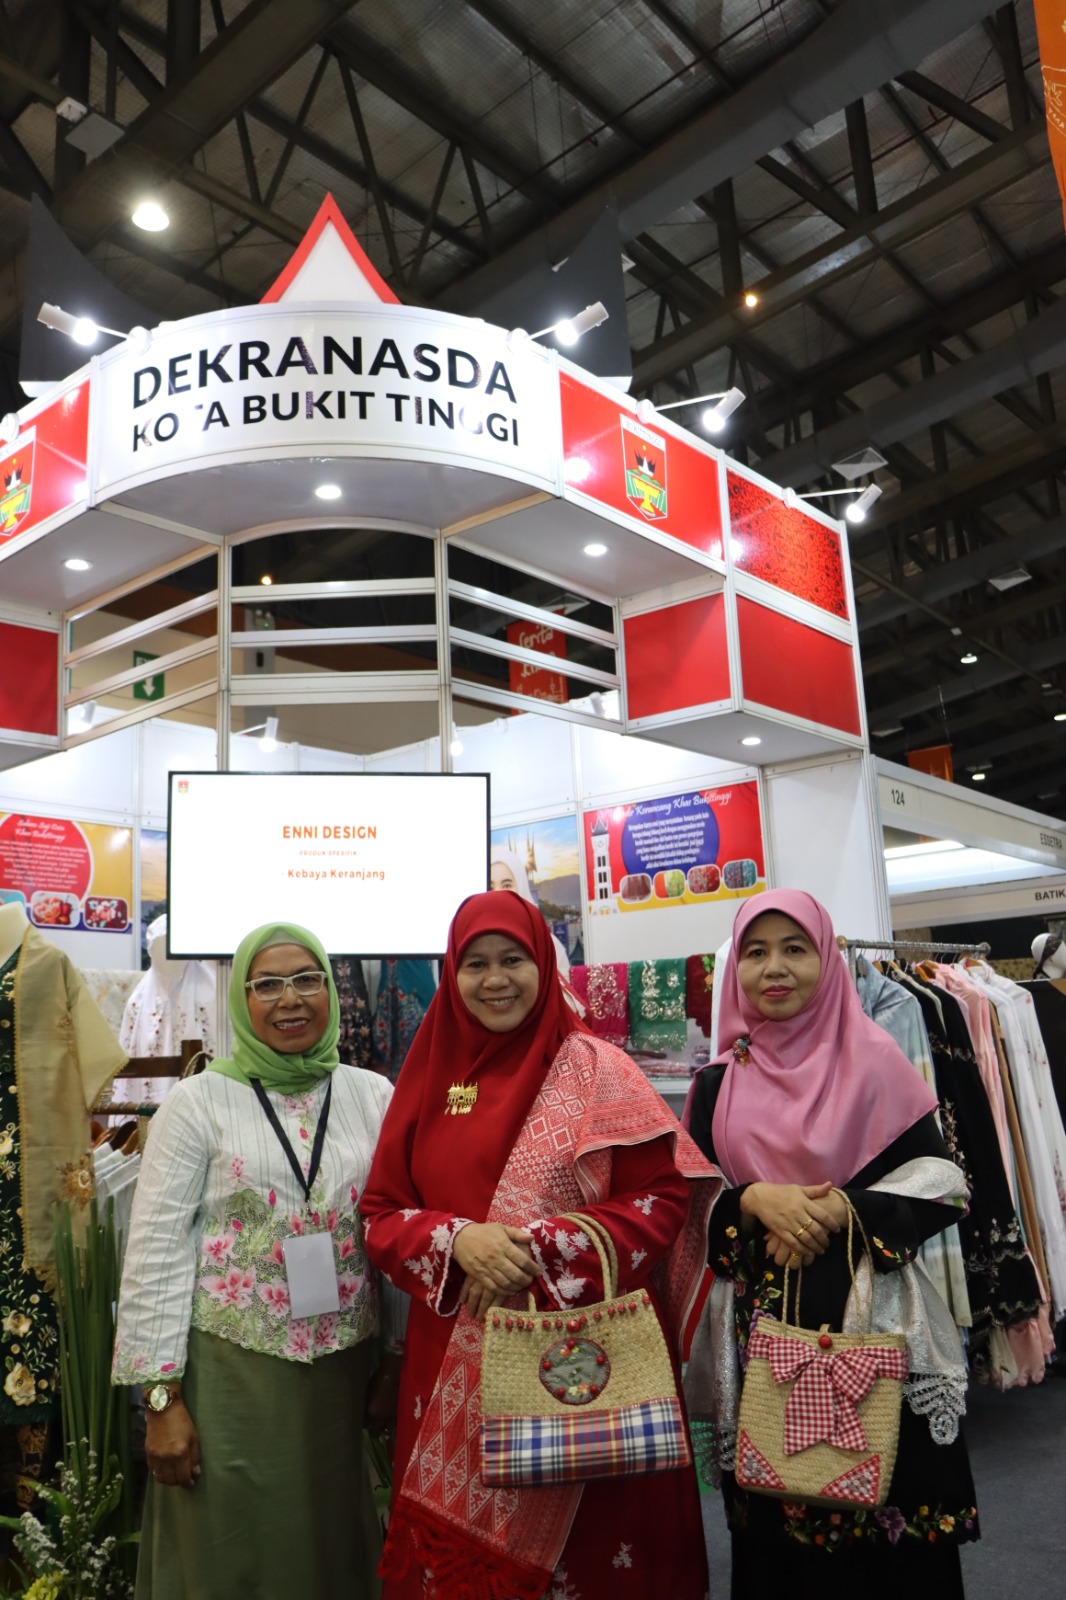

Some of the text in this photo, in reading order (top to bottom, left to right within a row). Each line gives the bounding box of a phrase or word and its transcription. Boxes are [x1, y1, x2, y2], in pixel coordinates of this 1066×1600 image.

[133, 336, 517, 409] DEKRANASDA
[133, 401, 230, 452] KOA
[673, 796, 691, 808] Khas
[891, 788, 905, 806] 124
[283, 825, 377, 839] ENNI DESIGN
[287, 868, 385, 880] Kebaya Keranjang
[1035, 889, 1066, 902] BATIK
